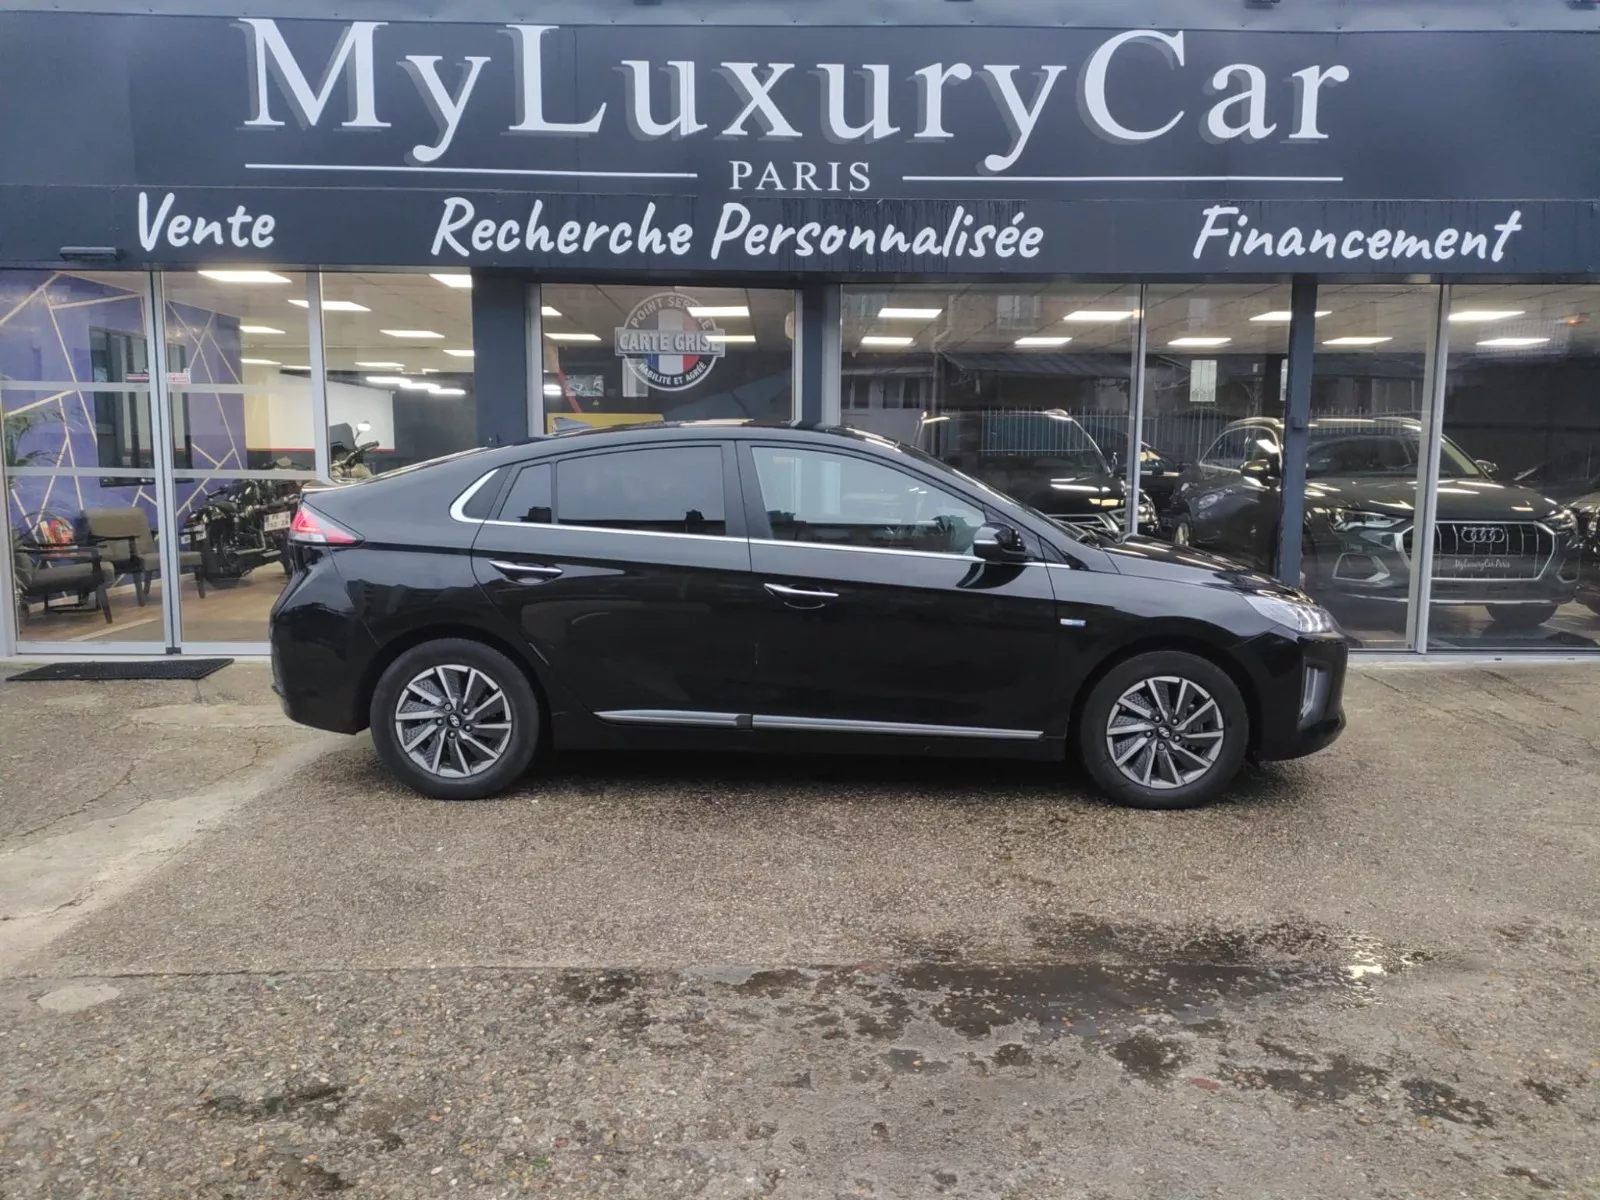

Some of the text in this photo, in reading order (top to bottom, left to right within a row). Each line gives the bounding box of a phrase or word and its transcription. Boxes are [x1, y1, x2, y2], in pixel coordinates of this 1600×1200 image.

[240, 17, 1350, 172] MyLuxuryCar
[729, 160, 871, 192] PARIS
[138, 191, 276, 252] Vente
[431, 197, 1044, 260] Recherche Personnalisée
[1193, 204, 1522, 263] Financement
[630, 298, 663, 328] POINT
[618, 332, 670, 352] CARTE
[673, 375, 683, 385] ET
